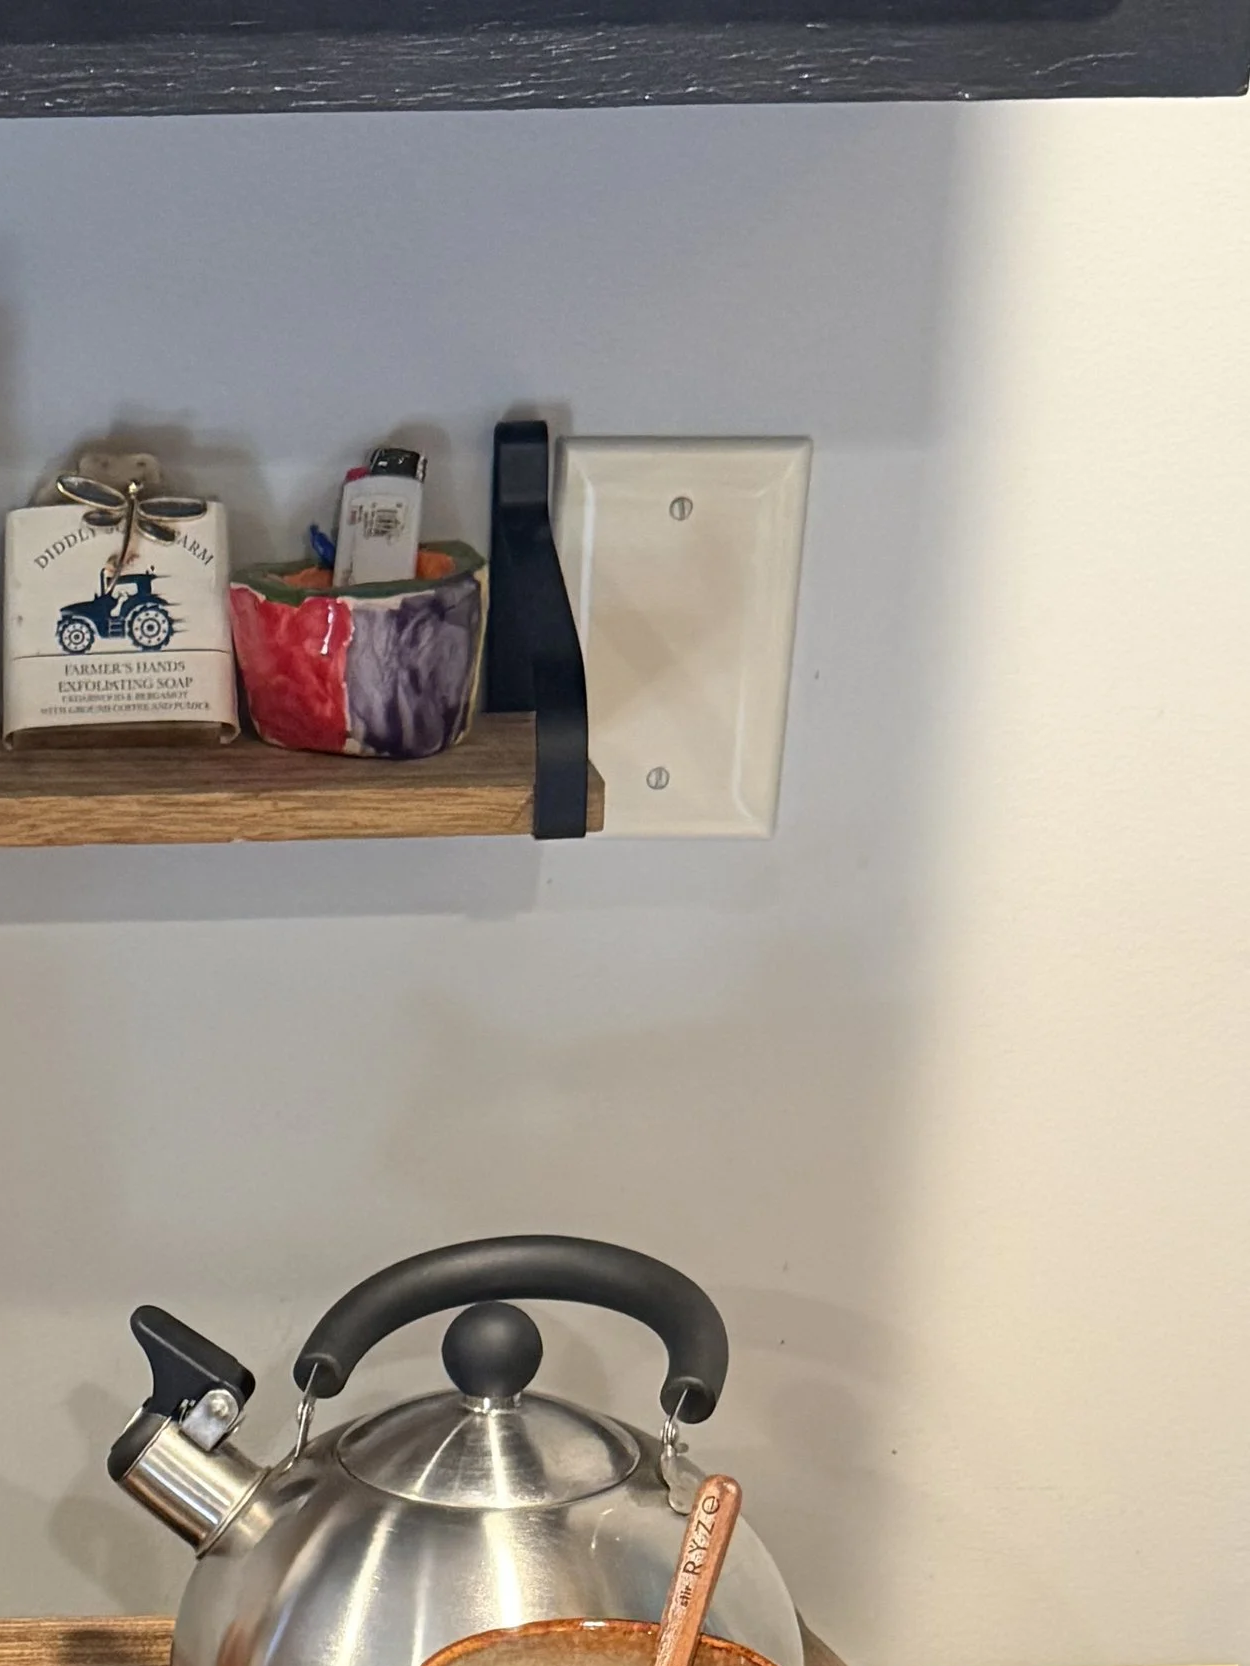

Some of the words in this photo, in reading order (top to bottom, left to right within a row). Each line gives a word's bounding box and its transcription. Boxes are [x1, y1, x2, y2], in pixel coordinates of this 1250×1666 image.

[65, 662, 133, 676] FARMER'S
[136, 661, 186, 674] HANDS
[58, 679, 154, 693] EXFOLIATING
[156, 676, 193, 690] SOAP
[680, 1583, 693, 1608] stir
